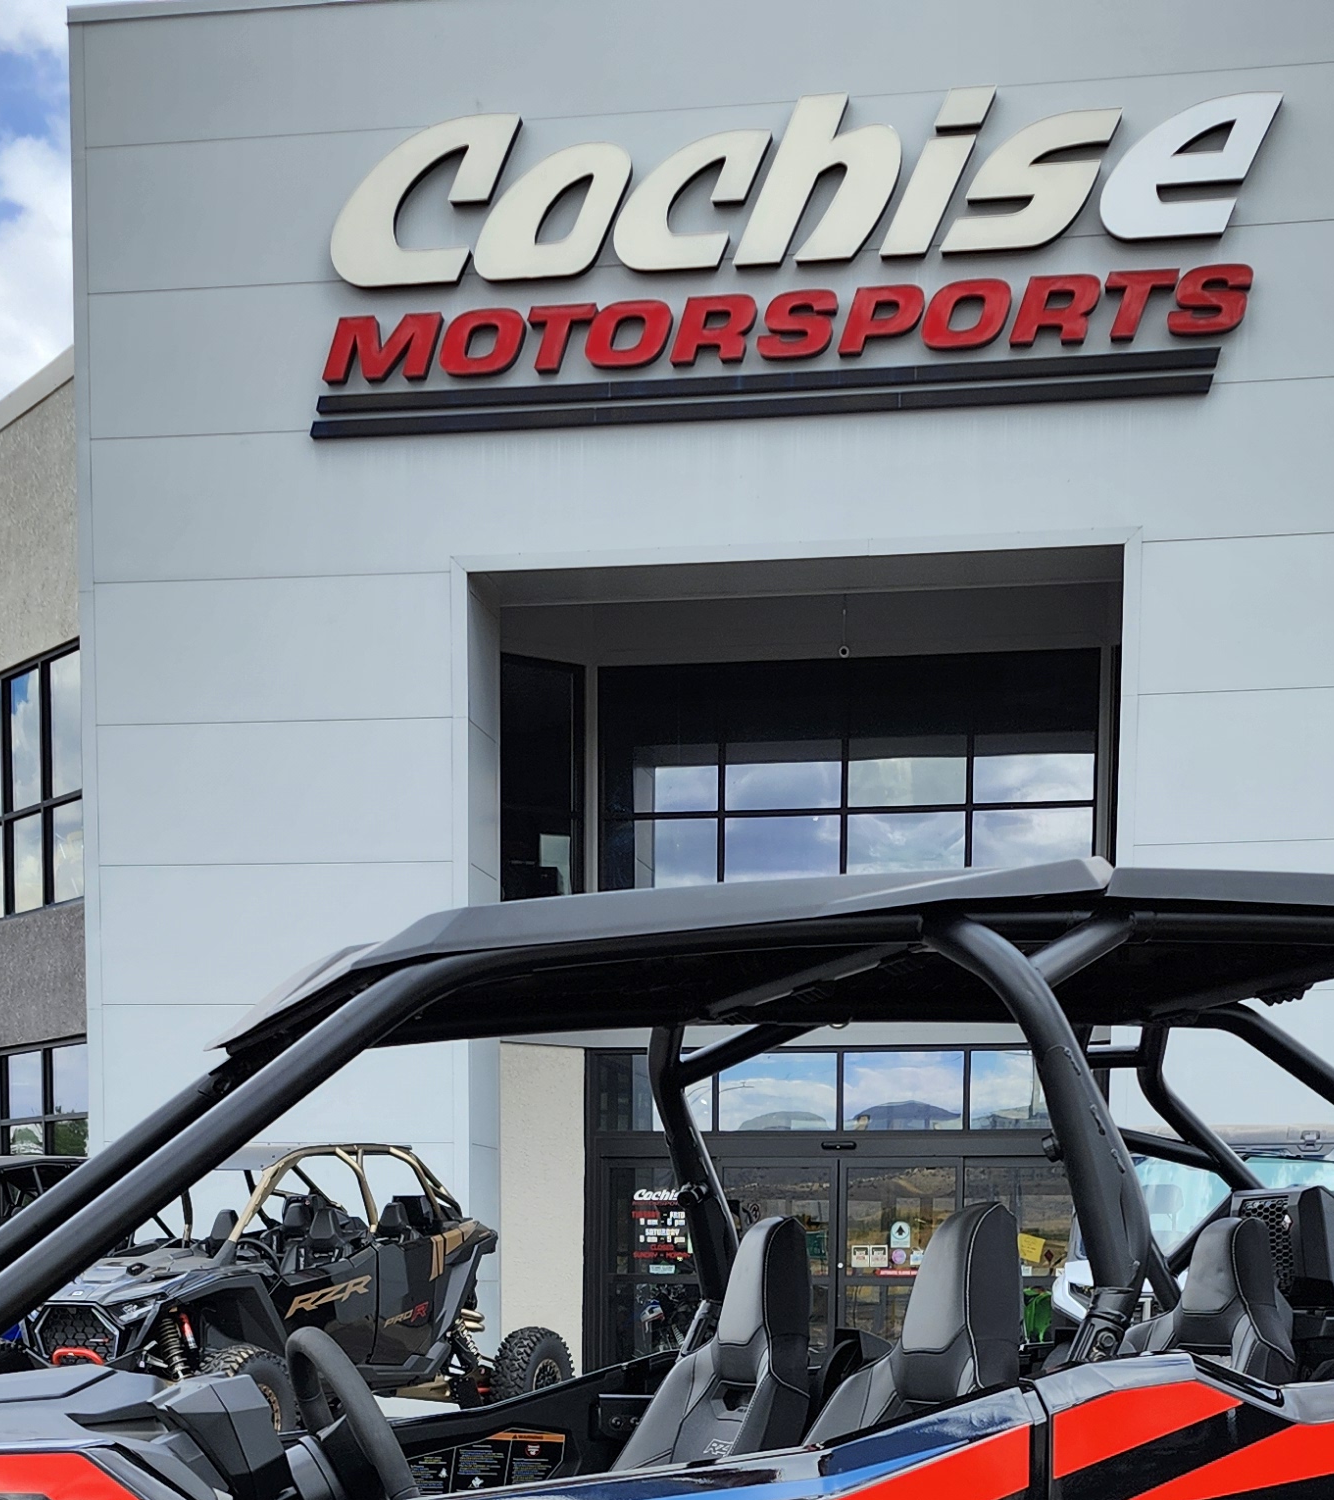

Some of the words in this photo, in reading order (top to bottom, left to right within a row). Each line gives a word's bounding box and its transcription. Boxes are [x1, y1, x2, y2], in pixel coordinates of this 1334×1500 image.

[329, 85, 1284, 288] Cochise
[322, 263, 1253, 384] MOTORSPORTS
[633, 1188, 680, 1201] Cochi
[284, 1274, 372, 1320] RZR
